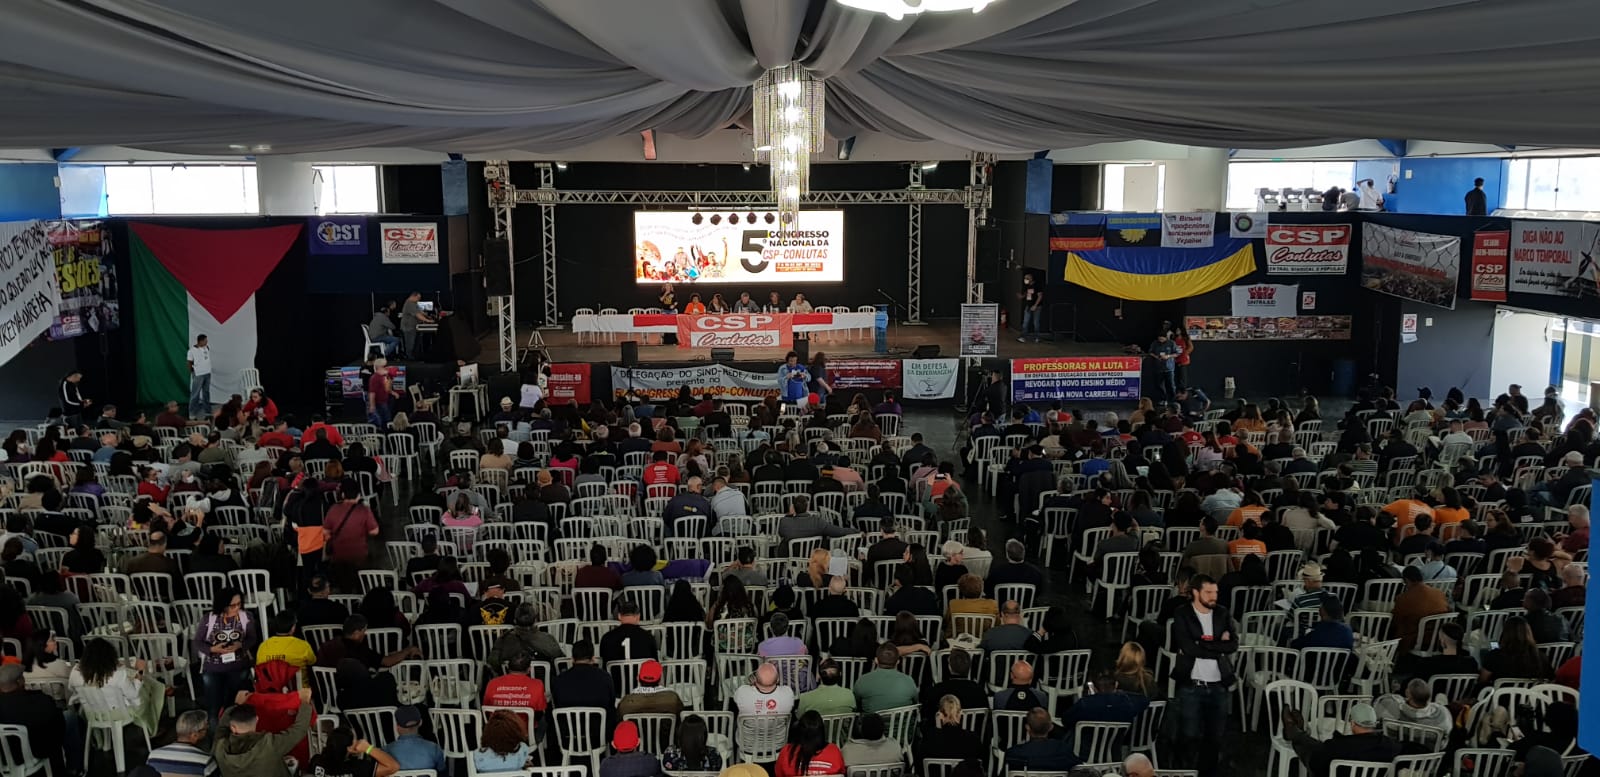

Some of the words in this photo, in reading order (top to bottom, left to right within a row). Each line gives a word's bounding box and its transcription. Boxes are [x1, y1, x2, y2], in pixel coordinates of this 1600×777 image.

[333, 224, 361, 240] CST
[769, 231, 829, 239] CONGRESSO
[1270, 229, 1345, 243] CSP
[1522, 229, 1538, 243] DIGA
[1538, 227, 1553, 244] NÃO
[1554, 230, 1564, 244] AO
[769, 239, 815, 247] NACIONAL
[763, 249, 827, 260] CSP-CONLUTAS
[1270, 246, 1343, 264] Conlutas
[1514, 248, 1535, 262] MARCO
[1476, 263, 1503, 273] CSP
[697, 316, 773, 329] CSP
[697, 331, 774, 346] Conlutas
[923, 362, 948, 370] DEFESA
[1023, 361, 1087, 371] PROFESSORAS
[1089, 361, 1101, 370] NA
[1103, 361, 1124, 369] LUTA
[620, 369, 674, 380] DELEGAÇÃO
[679, 369, 692, 378] DO
[666, 378, 705, 387] presente
[1025, 380, 1055, 388] REVOGAR
[1081, 379, 1104, 387] ENSINO
[1034, 391, 1038, 399] E
[1040, 391, 1045, 399] A
[1085, 390, 1118, 398] CARREIRA!
[621, 638, 630, 661] 1
